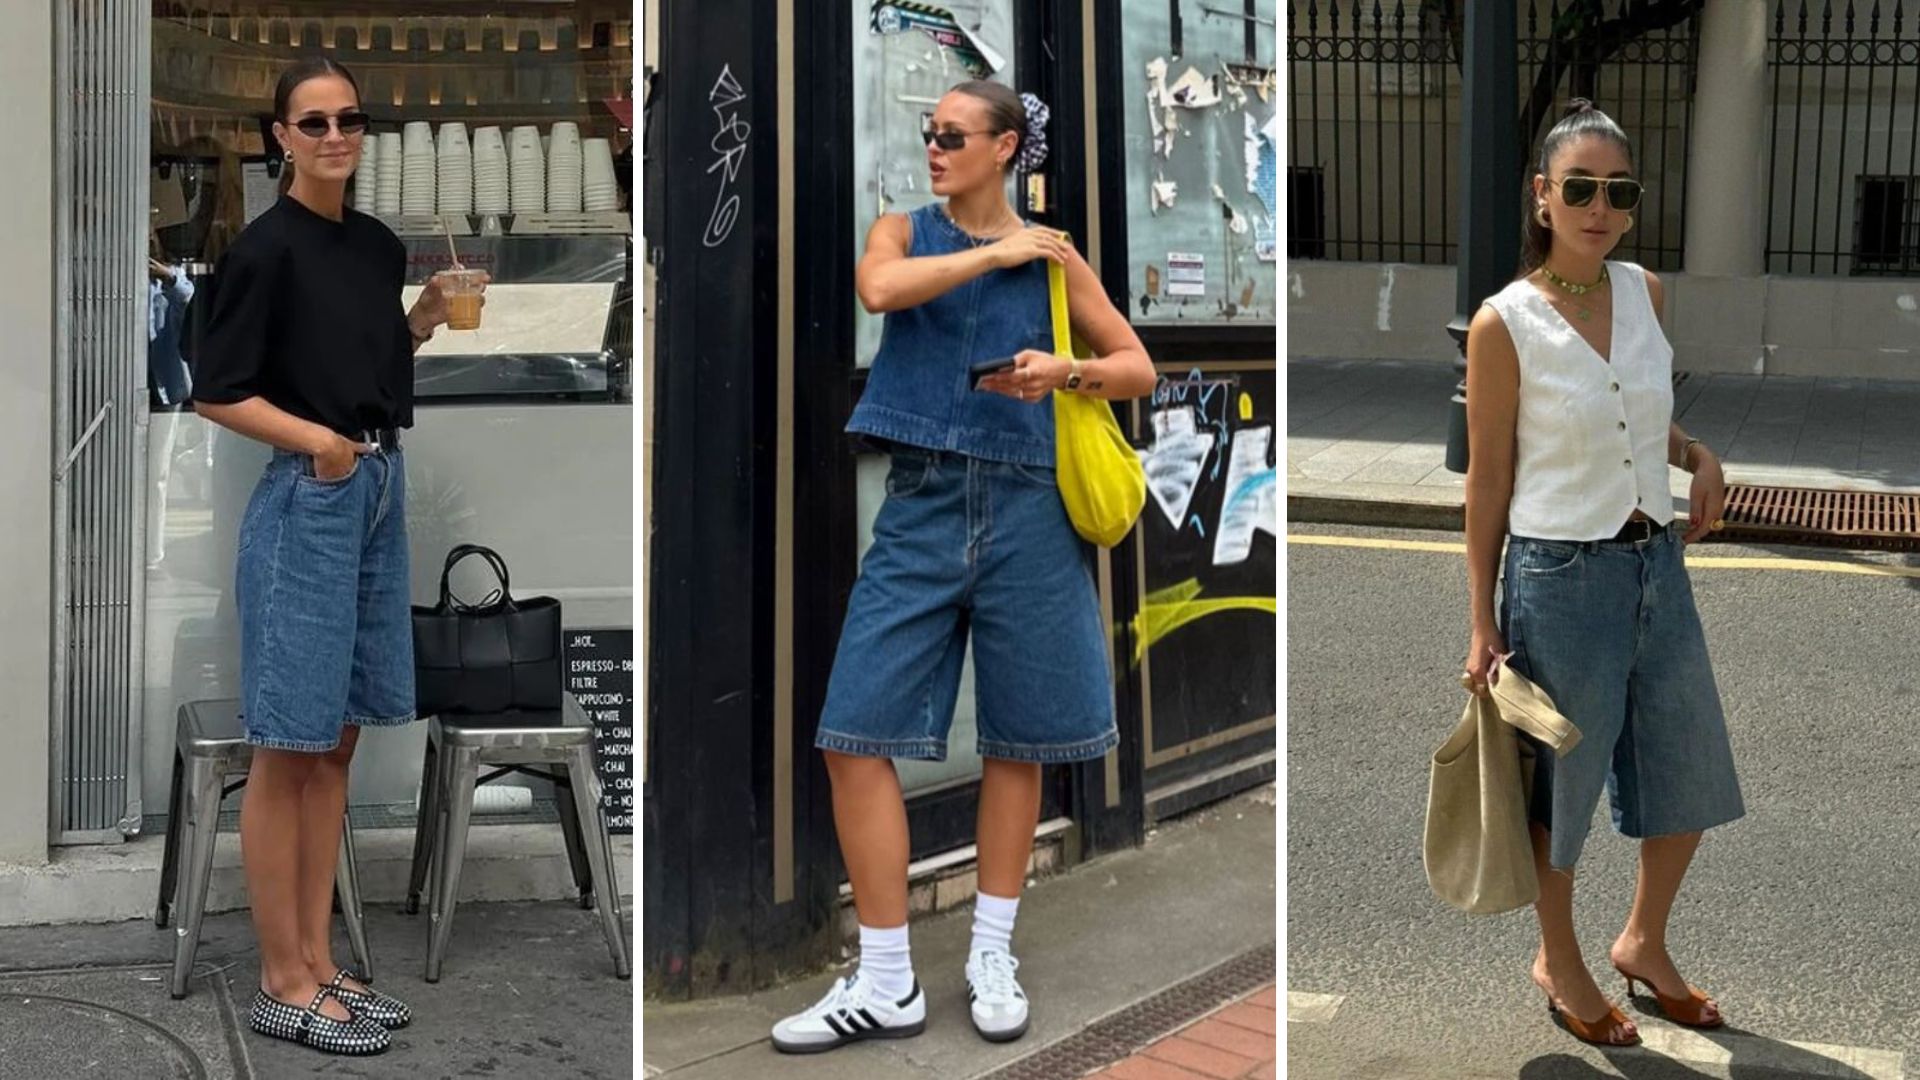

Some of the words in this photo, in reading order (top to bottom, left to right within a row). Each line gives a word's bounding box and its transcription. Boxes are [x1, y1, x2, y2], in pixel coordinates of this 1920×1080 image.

[571, 660, 614, 672] ESPRESSO
[621, 660, 633, 672] DB
[571, 677, 598, 689] FILTRE
[595, 710, 620, 721] WHITE
[612, 727, 632, 738] CHAI
[614, 778, 633, 790] CHO
